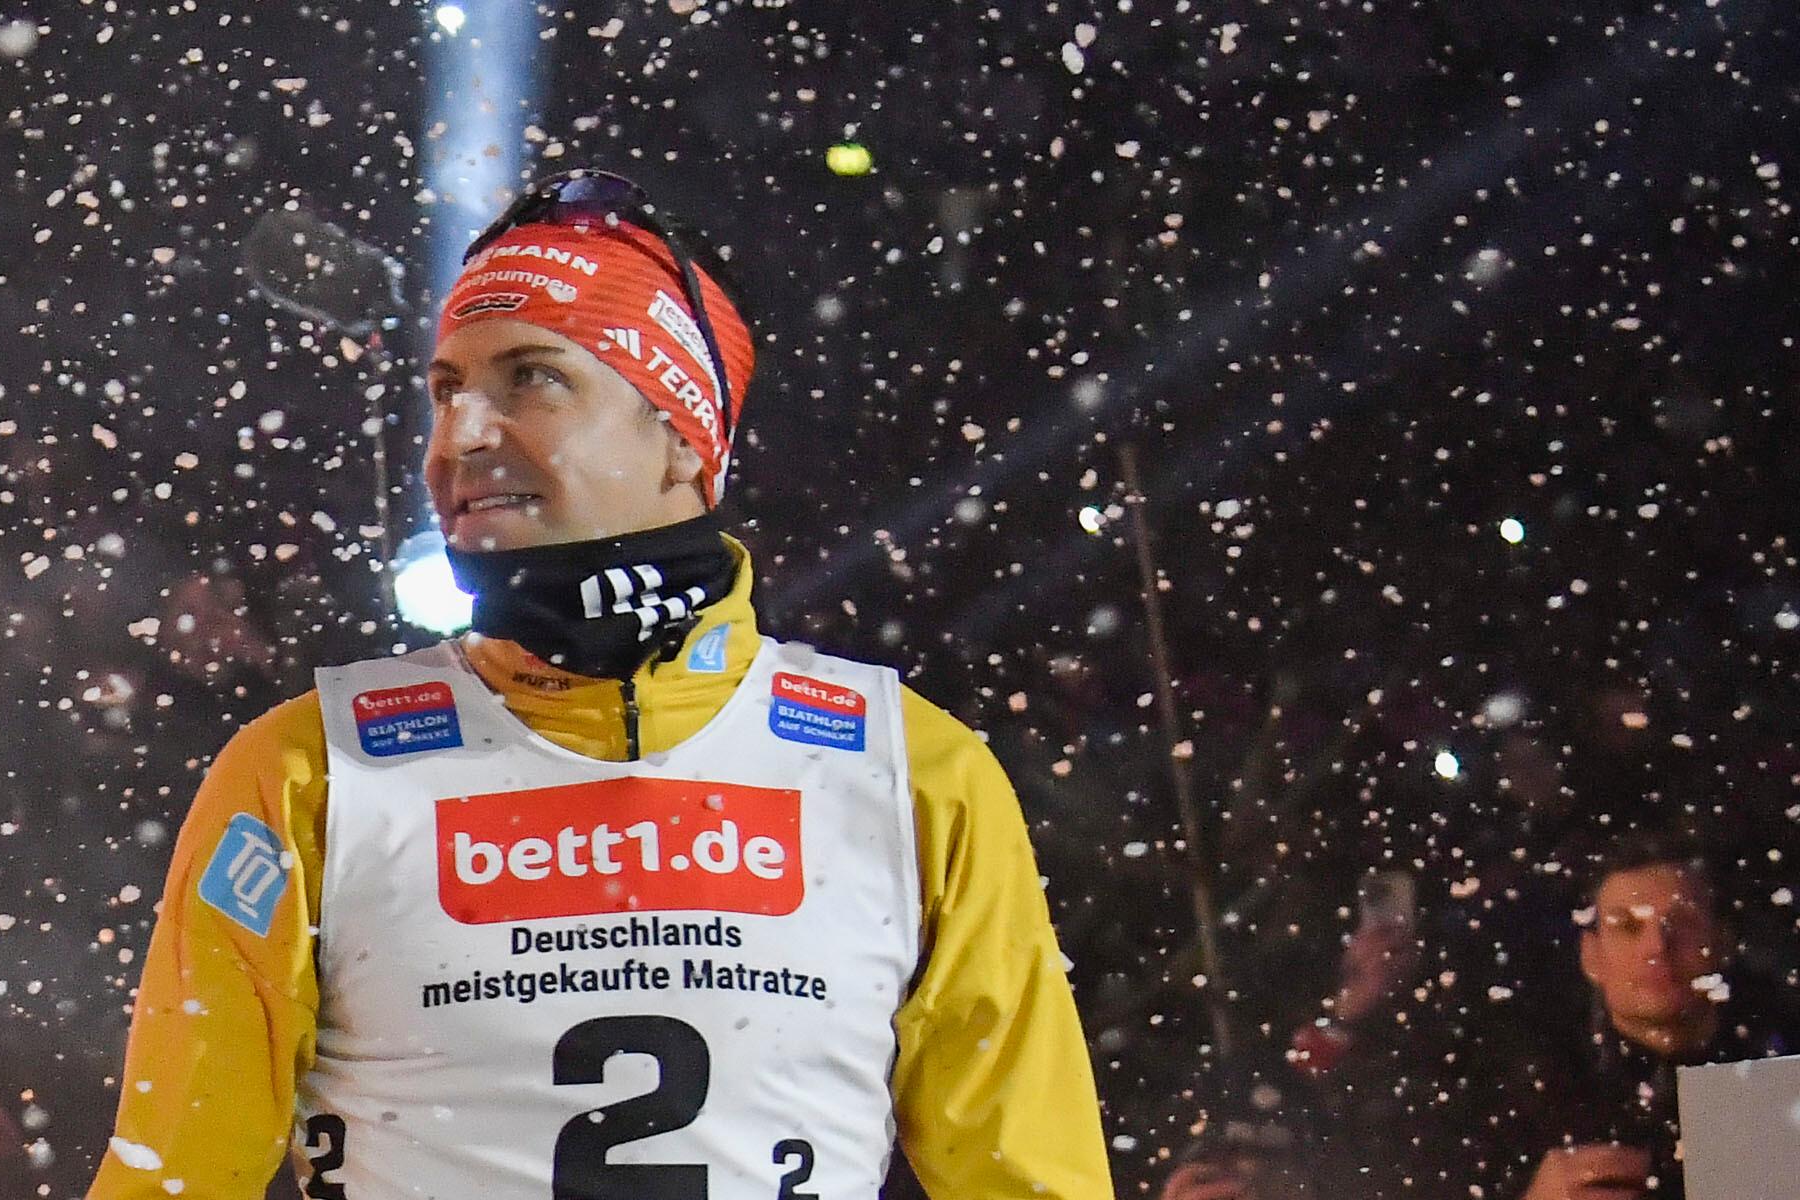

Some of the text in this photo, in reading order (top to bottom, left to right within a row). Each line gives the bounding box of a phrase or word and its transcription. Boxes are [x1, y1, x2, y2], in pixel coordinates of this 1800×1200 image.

[781, 678, 857, 708] bett1.de
[367, 714, 448, 737] BIATHLON
[777, 705, 856, 730] BIATHLON
[453, 819, 785, 885] bett1.de
[511, 917, 742, 955] Deutschlands
[422, 959, 827, 1008] meistgekaufte Matratze
